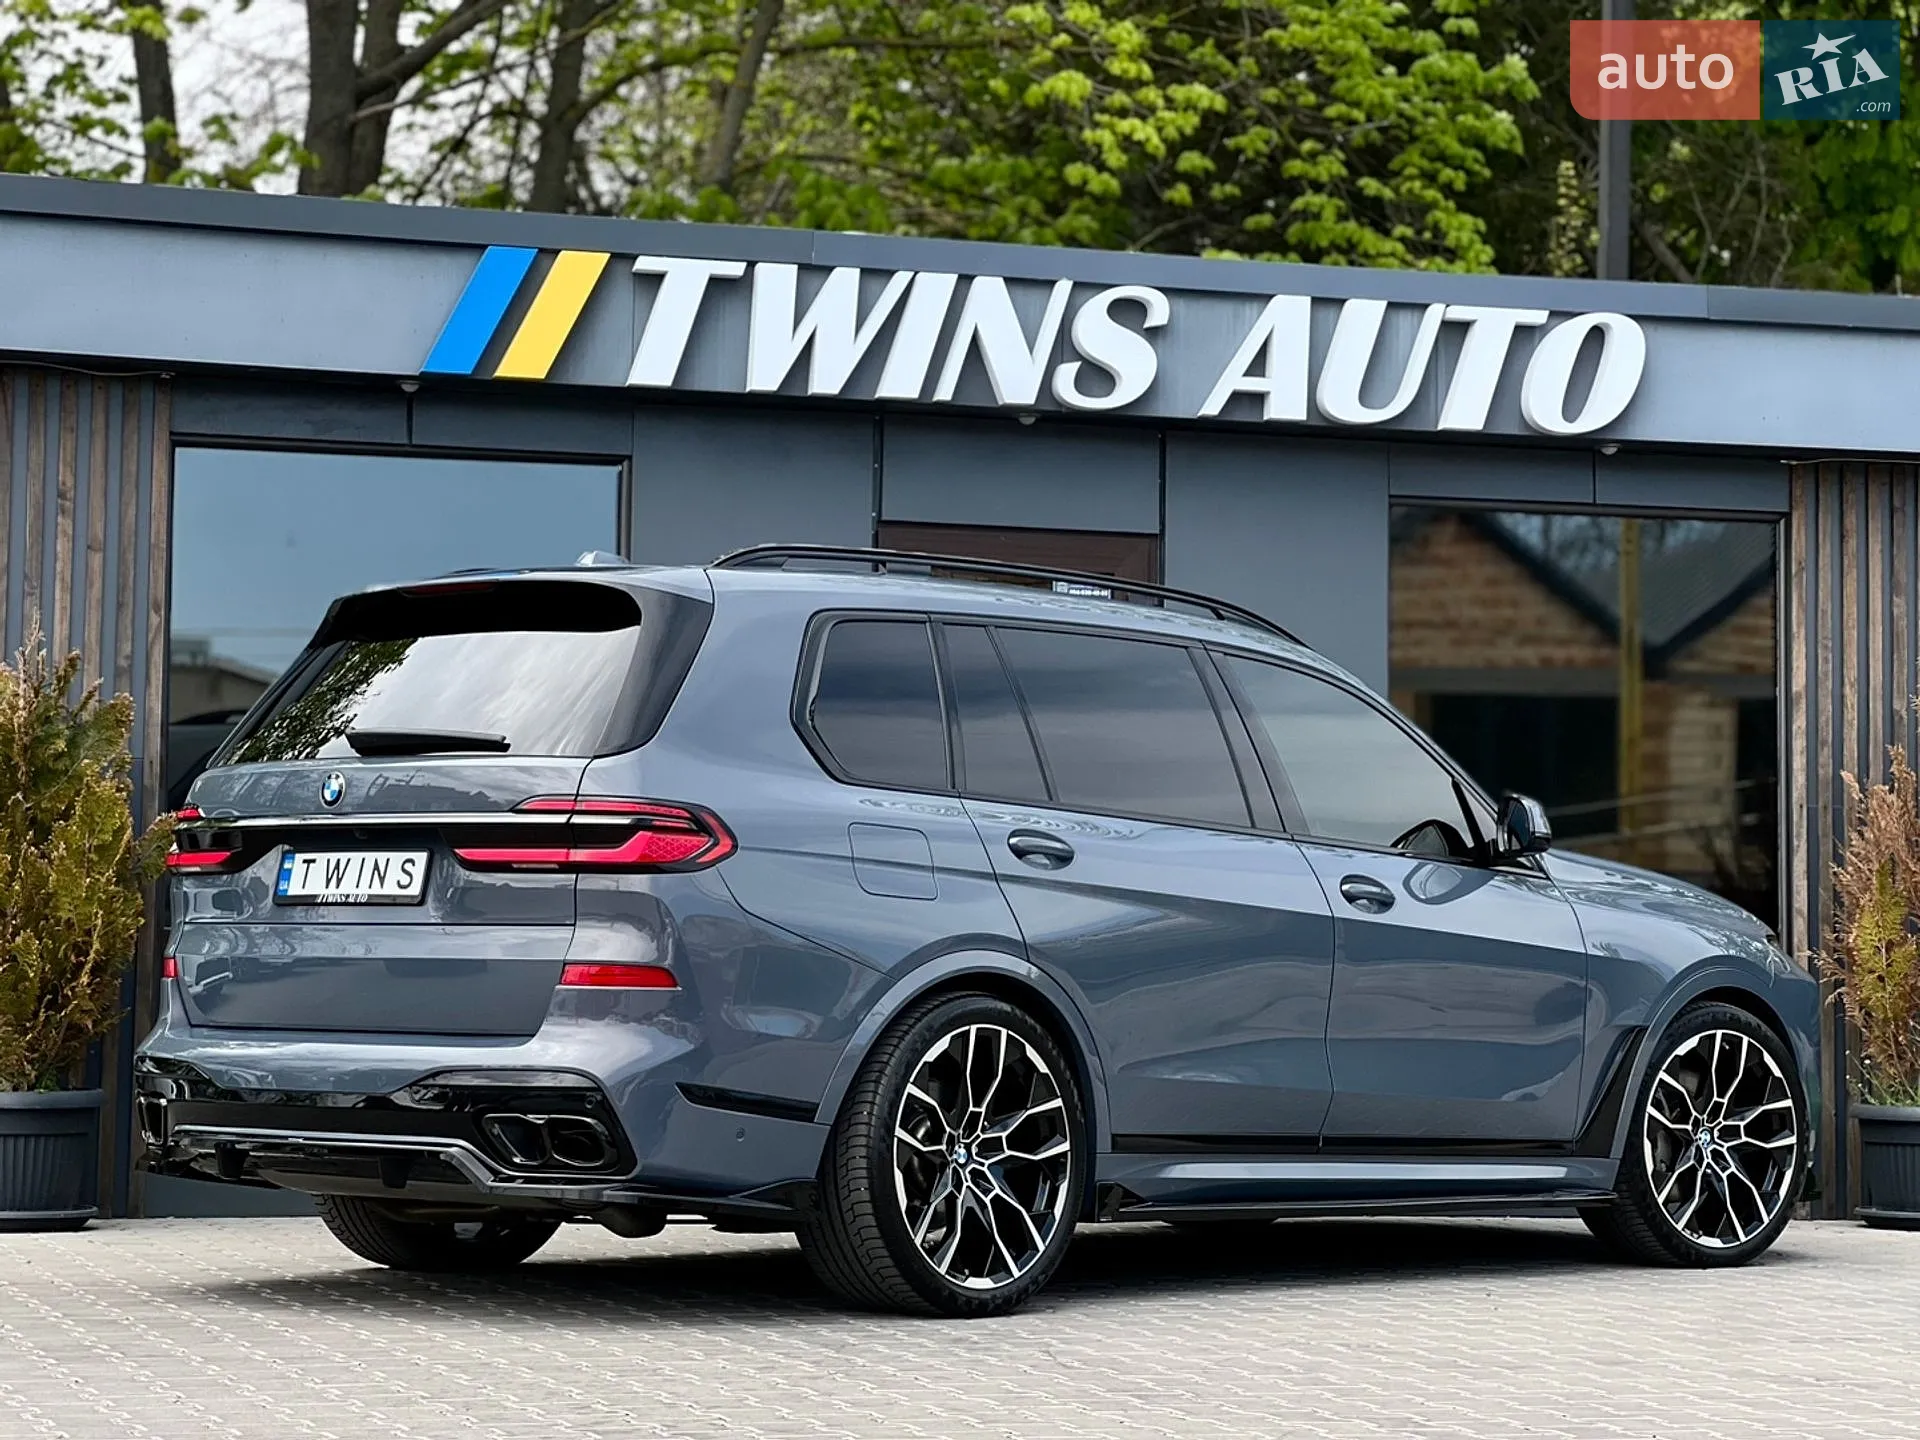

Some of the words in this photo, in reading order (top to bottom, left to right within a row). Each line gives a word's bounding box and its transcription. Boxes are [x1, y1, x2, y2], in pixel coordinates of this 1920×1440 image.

[625, 255, 1170, 410] TWINS
[1196, 294, 1646, 436] AUTO
[301, 857, 416, 889] TWINS
